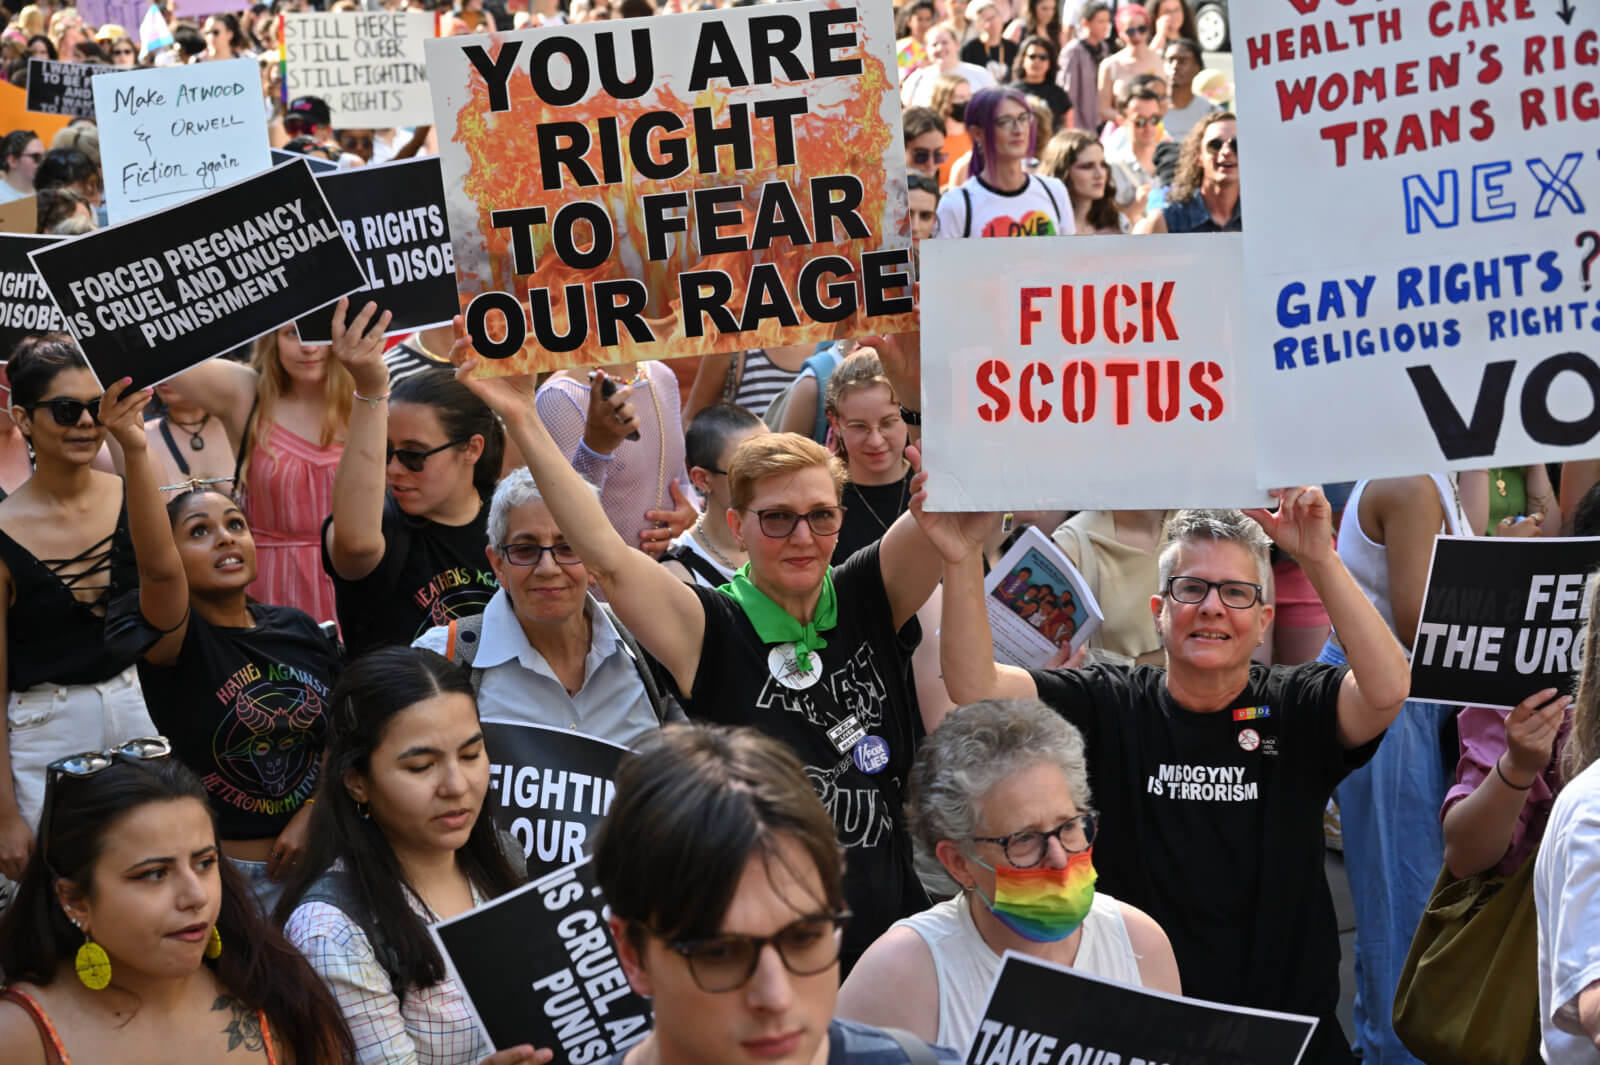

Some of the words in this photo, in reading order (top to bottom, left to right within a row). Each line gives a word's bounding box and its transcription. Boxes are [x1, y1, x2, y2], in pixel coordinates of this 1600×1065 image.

[285, 18, 349, 39] STILL
[355, 15, 408, 38] HERE
[287, 43, 350, 62] STILL
[354, 38, 406, 58] QUEER
[1246, 8, 1402, 70] HEALTH
[1429, 0, 1535, 37] CARE
[42, 72, 60, 85] TO
[288, 68, 351, 88] STILL
[461, 28, 655, 113] YOU
[688, 7, 865, 93] ARE
[1276, 40, 1502, 122] WOMEN'S
[65, 86, 92, 99] AND
[113, 86, 166, 115] Make
[177, 82, 245, 108] ATWOOD
[341, 89, 404, 113] RIGHTS
[171, 115, 244, 137] ORWELL
[535, 97, 809, 192] RIGHT
[1321, 99, 1495, 167] TRANS
[122, 160, 188, 195] Fiction
[196, 154, 240, 190] again
[1402, 148, 1600, 234] NEX
[69, 257, 164, 307] FORCED
[163, 199, 306, 275] PREGNANCY
[361, 204, 444, 250] RIGHTS
[491, 201, 614, 277] TO
[642, 174, 872, 262] FEAR
[66, 311, 96, 340] IS
[96, 288, 176, 332] CRUEL
[177, 266, 227, 305] AND
[226, 218, 340, 281] UNUSUAL
[140, 266, 290, 348] PUNISHMENT
[465, 278, 657, 360] OUR
[679, 248, 915, 340] RAGE
[1277, 275, 1376, 329] GAY
[1397, 250, 1563, 311] RIGHTS
[1020, 281, 1179, 346] FUCK
[1273, 319, 1461, 371] RELIGIOUS
[976, 360, 1225, 425] SCOTUS
[1406, 352, 1600, 461] VO
[1420, 622, 1505, 672] THE
[268, 663, 330, 697] AGAINST
[864, 753, 889, 772] LIES
[1147, 776, 1164, 796] IS
[537, 869, 584, 911] IS
[557, 909, 632, 1017] CRUEL
